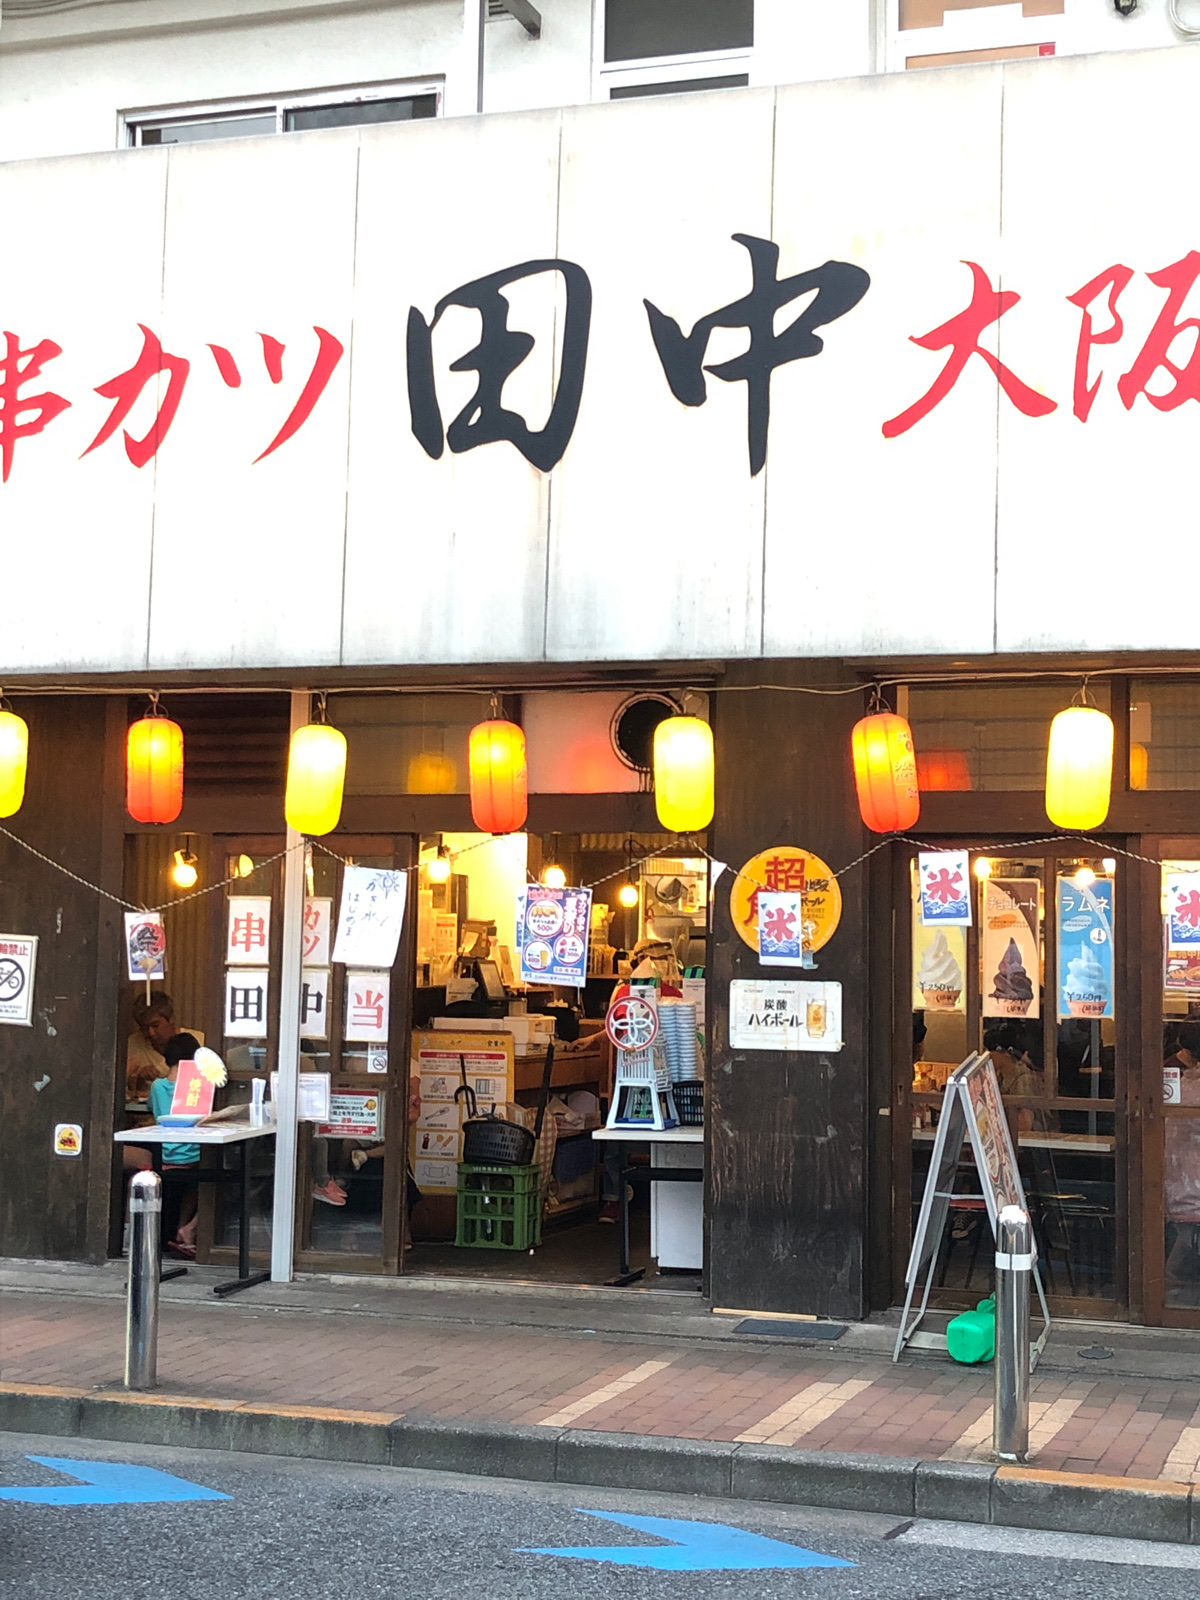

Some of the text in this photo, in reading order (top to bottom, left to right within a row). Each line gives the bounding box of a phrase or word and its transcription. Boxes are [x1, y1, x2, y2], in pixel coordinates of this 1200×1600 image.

[406, 233, 871, 479] 田中
[765, 856, 807, 893] 超
[925, 867, 963, 904] 氷
[988, 896, 1037, 911] チョコレート
[1061, 896, 1110, 912] ラムネ
[137, 926, 159, 952] 祭
[231, 912, 266, 953] 串
[763, 907, 797, 943] 氷
[230, 985, 264, 1023] 田
[351, 989, 384, 1029] 当
[748, 1012, 804, 1028] ハイボール
[763, 999, 788, 1011] 炭酸
